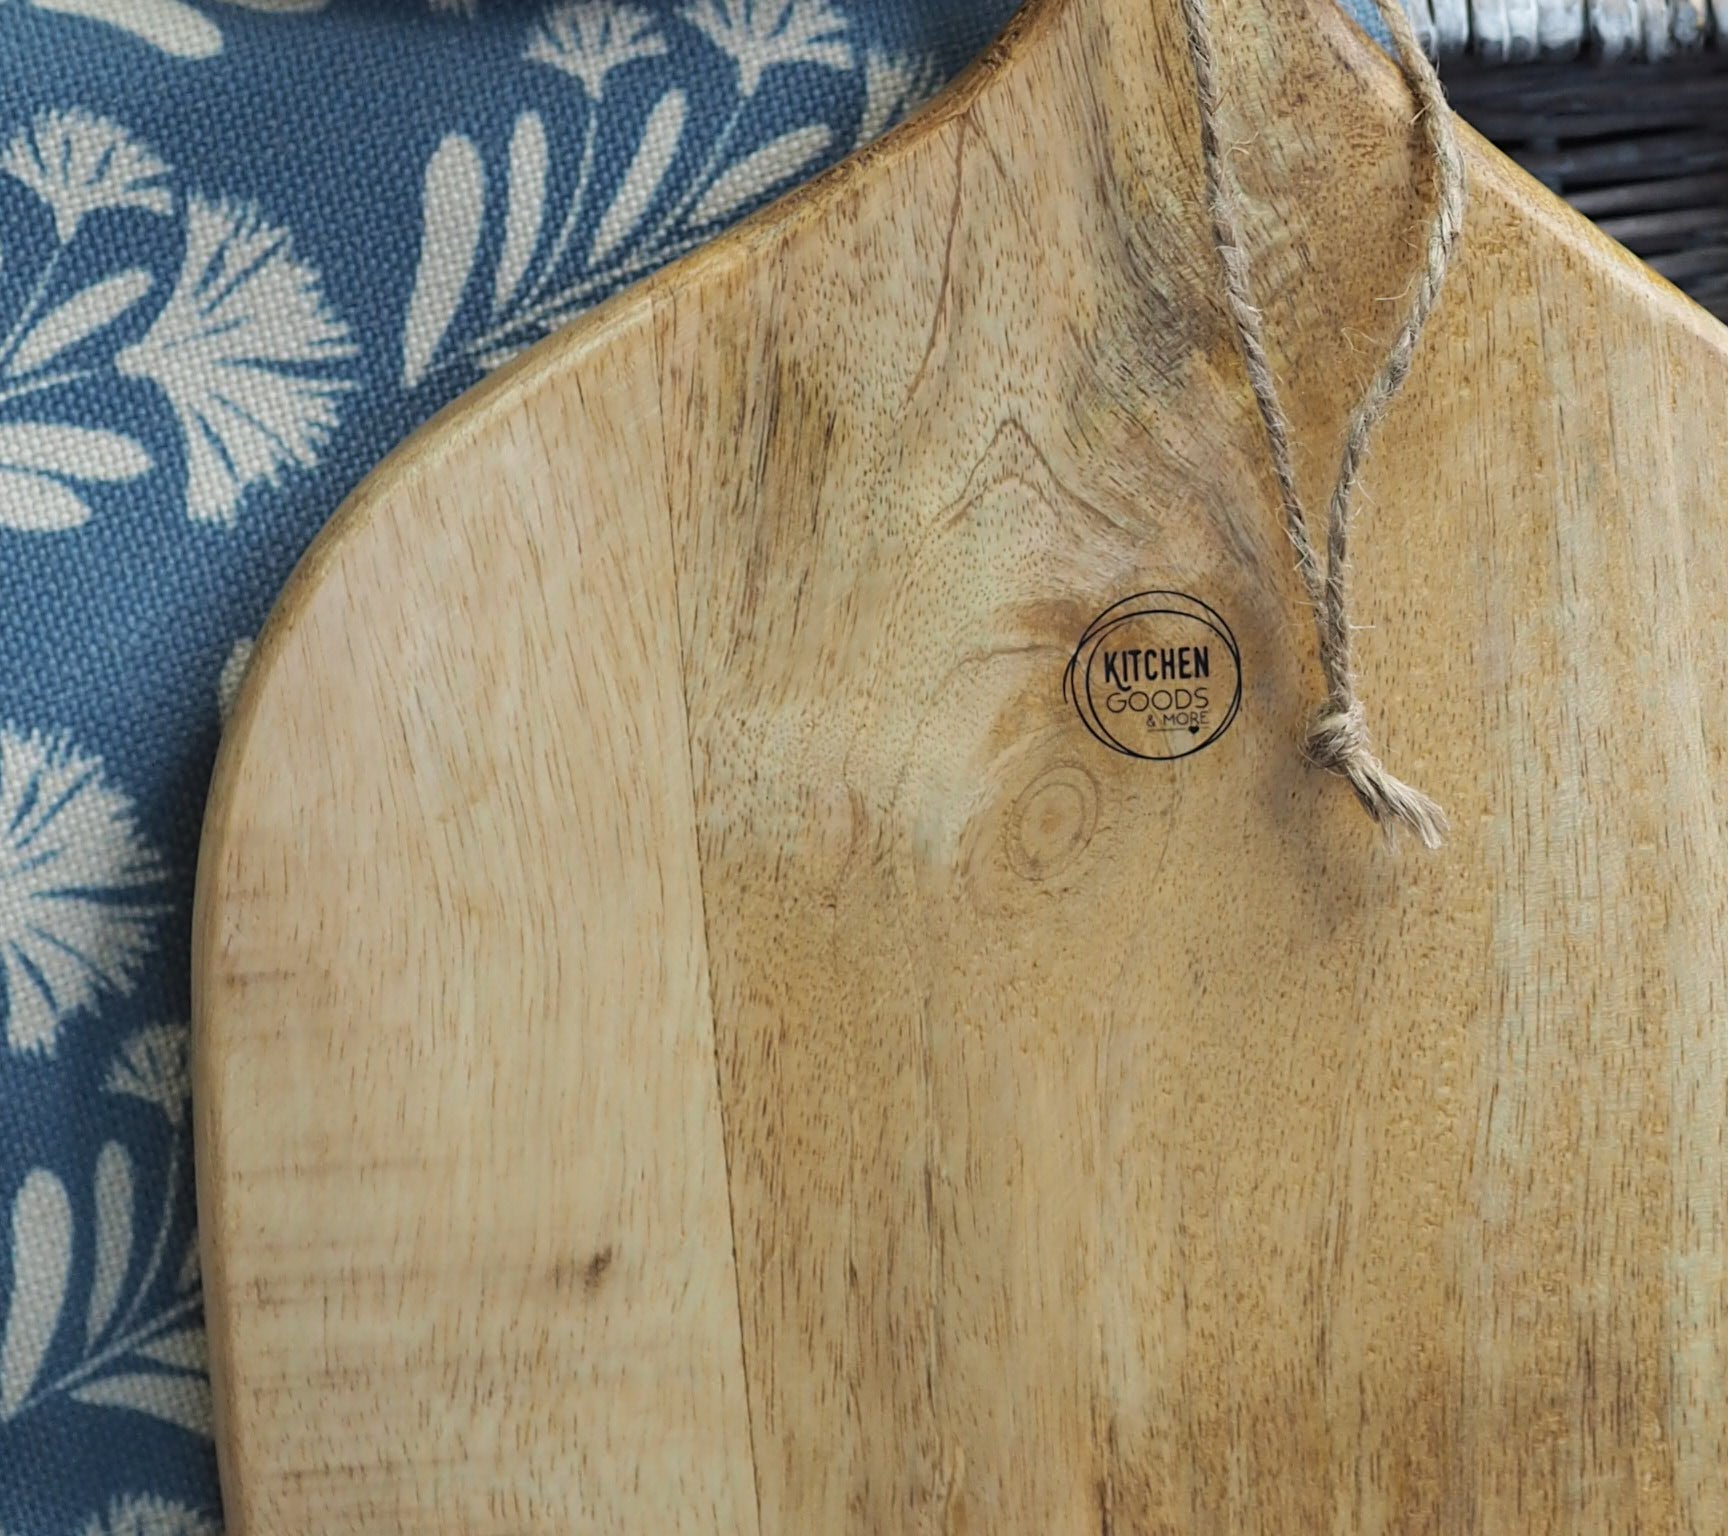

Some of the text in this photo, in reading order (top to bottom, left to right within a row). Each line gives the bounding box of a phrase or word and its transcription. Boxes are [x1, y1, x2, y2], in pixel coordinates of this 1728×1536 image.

[1104, 646, 1210, 691] KITCHEN
[1106, 687, 1209, 713] GOODS
[1146, 711, 1210, 727] & MORE
